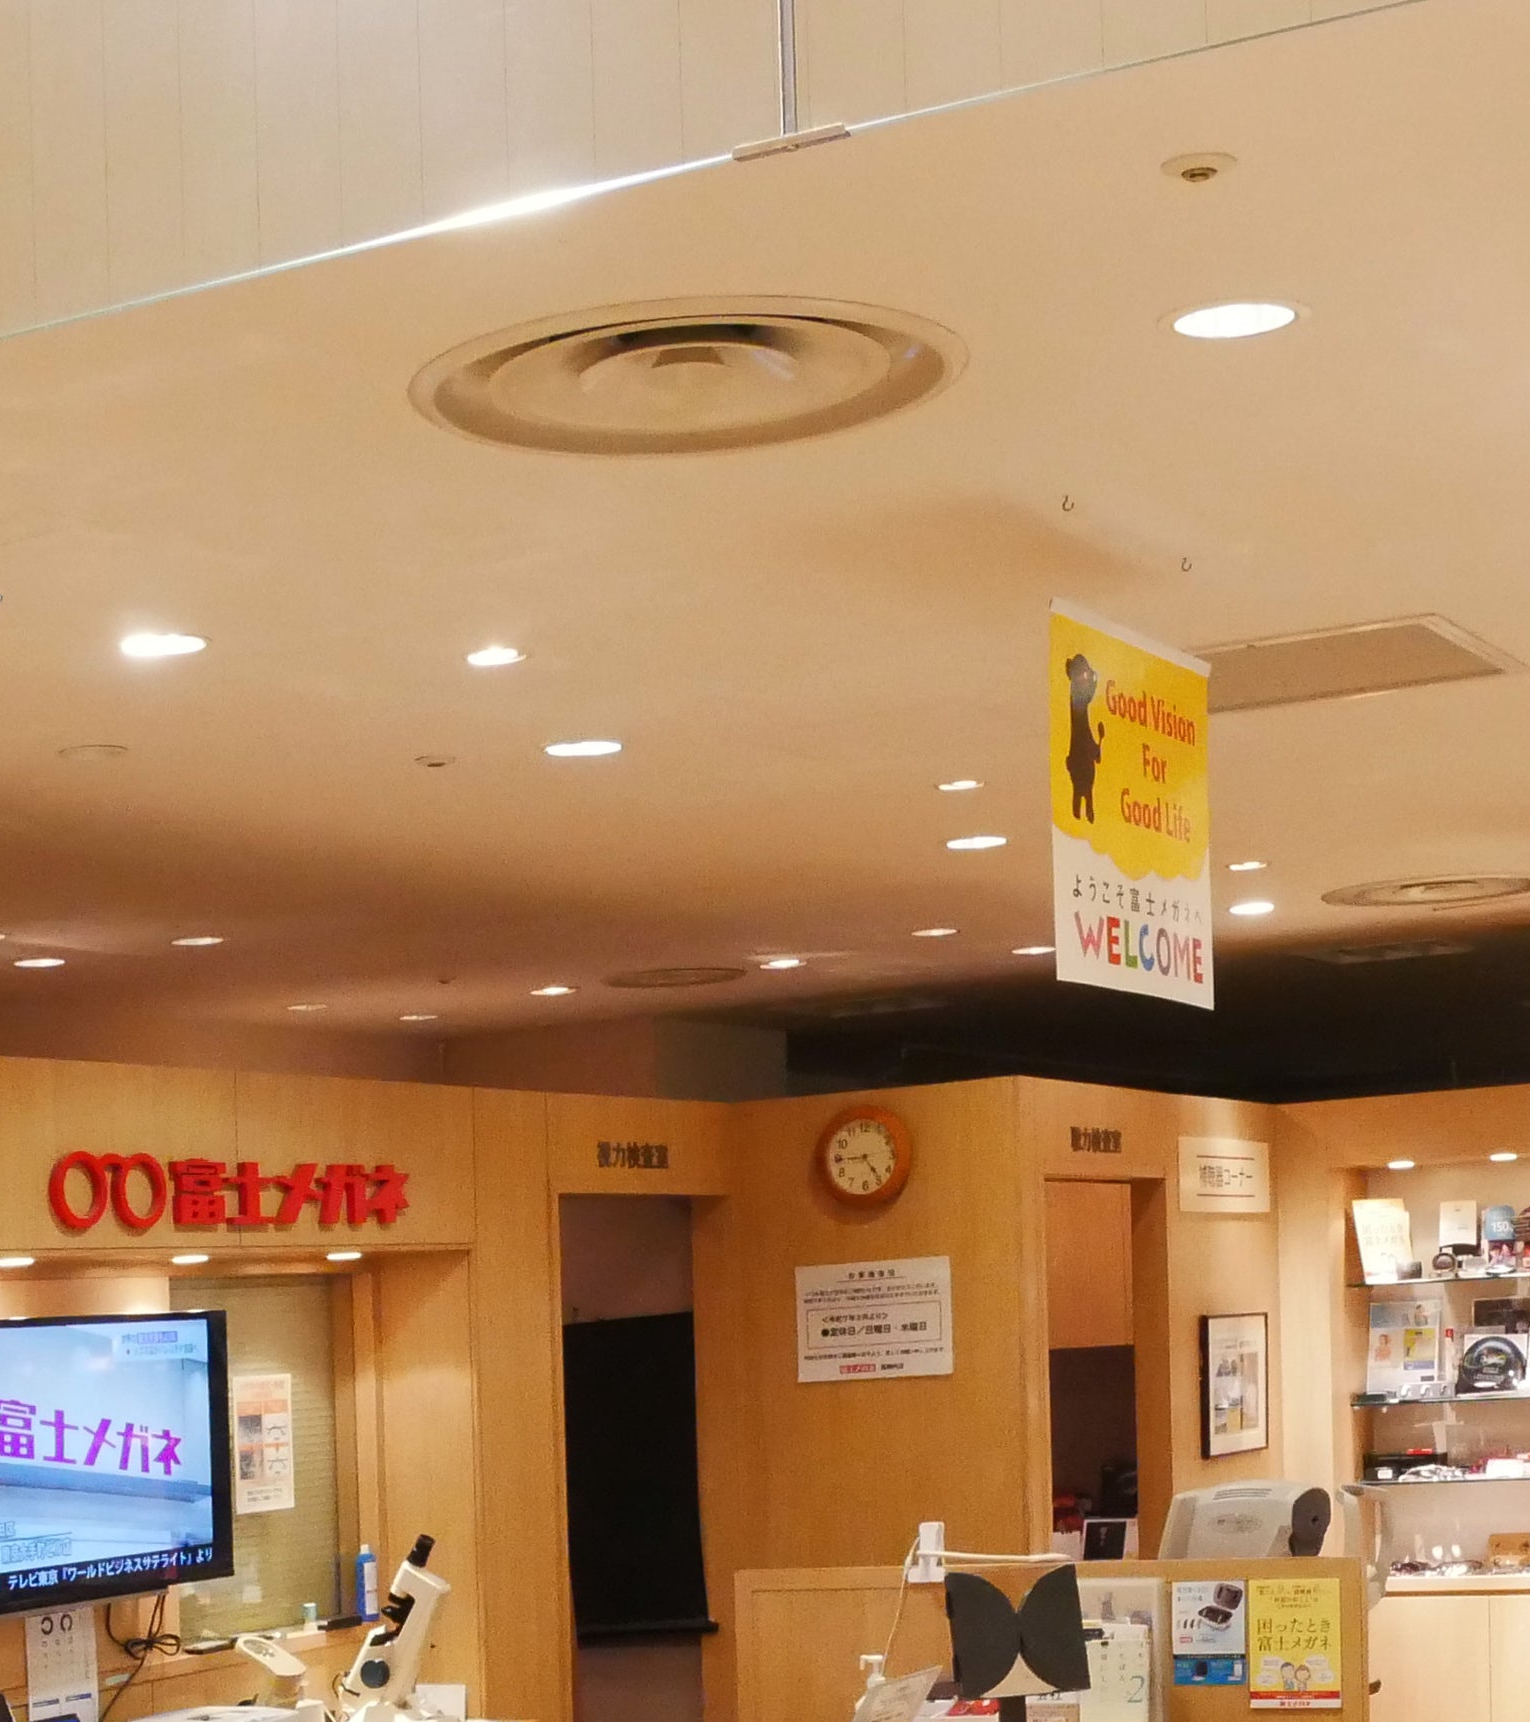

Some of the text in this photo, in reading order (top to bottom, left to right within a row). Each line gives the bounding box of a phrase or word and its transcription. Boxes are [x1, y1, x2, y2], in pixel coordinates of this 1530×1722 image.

[1105, 679, 1196, 748] Good Vision
[1142, 743, 1167, 785] For
[1120, 788, 1191, 845] Good Life
[1074, 910, 1204, 984] WELCOME
[168, 1158, 410, 1227] 富士メガネ
[1257, 1618, 1331, 1633] 困ったとき
[1257, 1636, 1331, 1651] 富士メガネ
